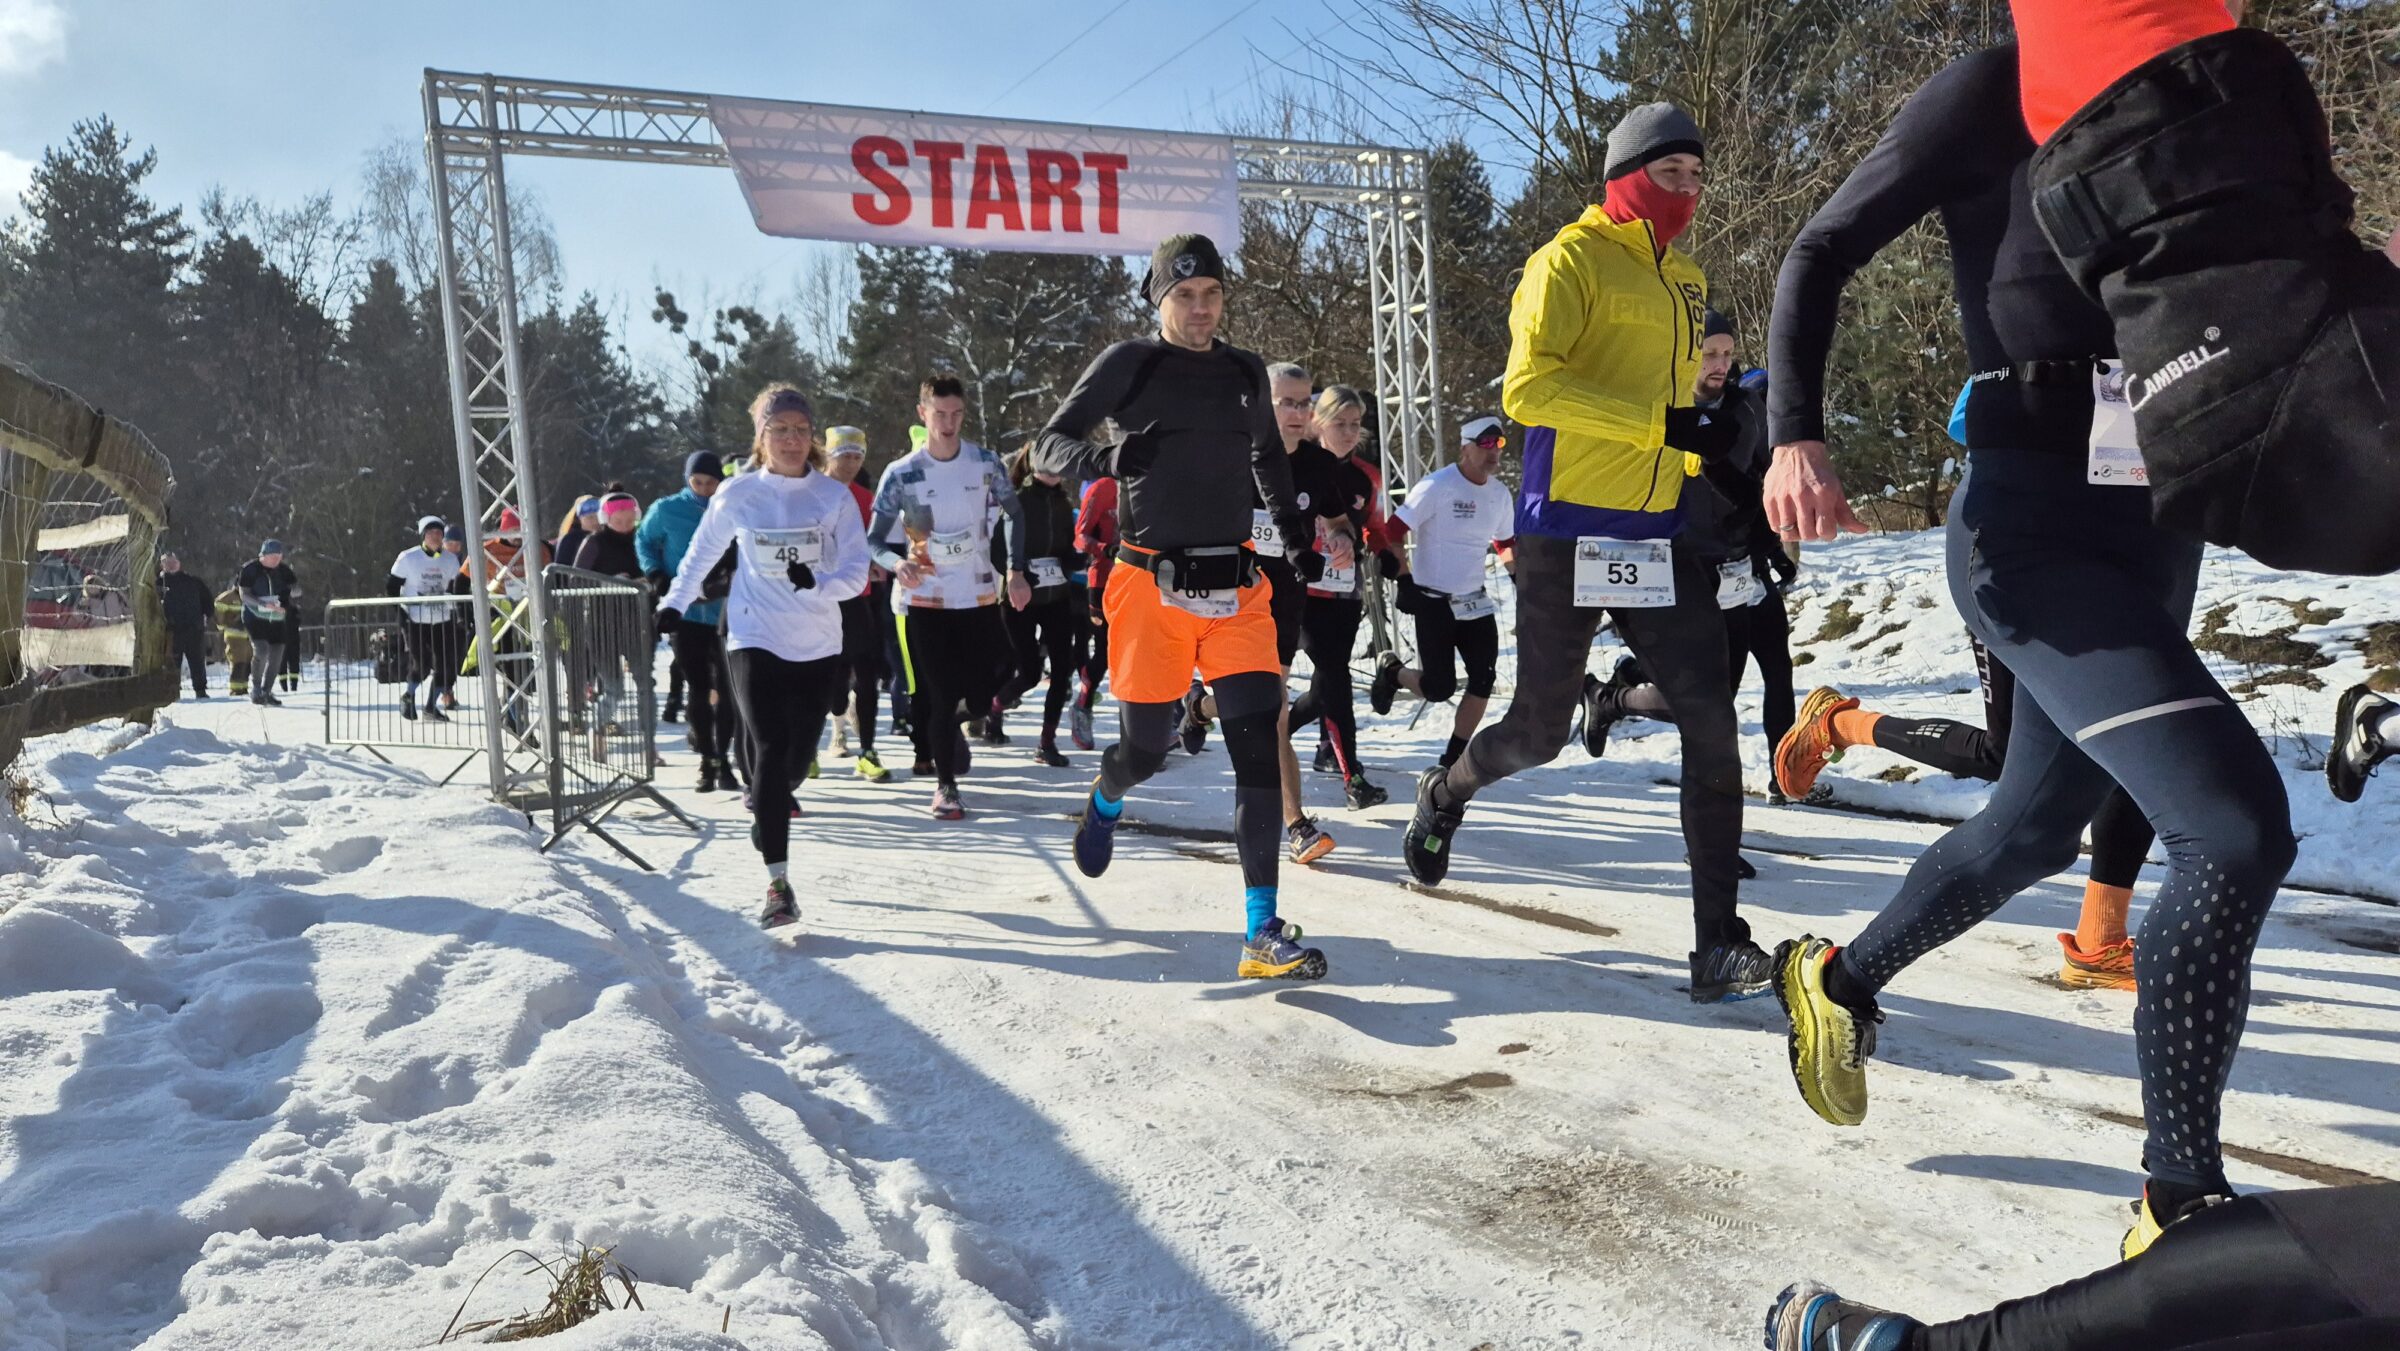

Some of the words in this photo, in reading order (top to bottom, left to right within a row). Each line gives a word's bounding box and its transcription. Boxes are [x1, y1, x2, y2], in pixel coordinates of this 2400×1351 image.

[850, 134, 1128, 235] START
[1252, 526, 1273, 542] 39
[774, 546, 800, 563] 48
[945, 544, 962, 555] 16
[1044, 565, 1056, 577] 14
[1324, 567, 1342, 581] 41
[1607, 563, 1638, 585] 53
[1734, 576, 1747, 592] 29
